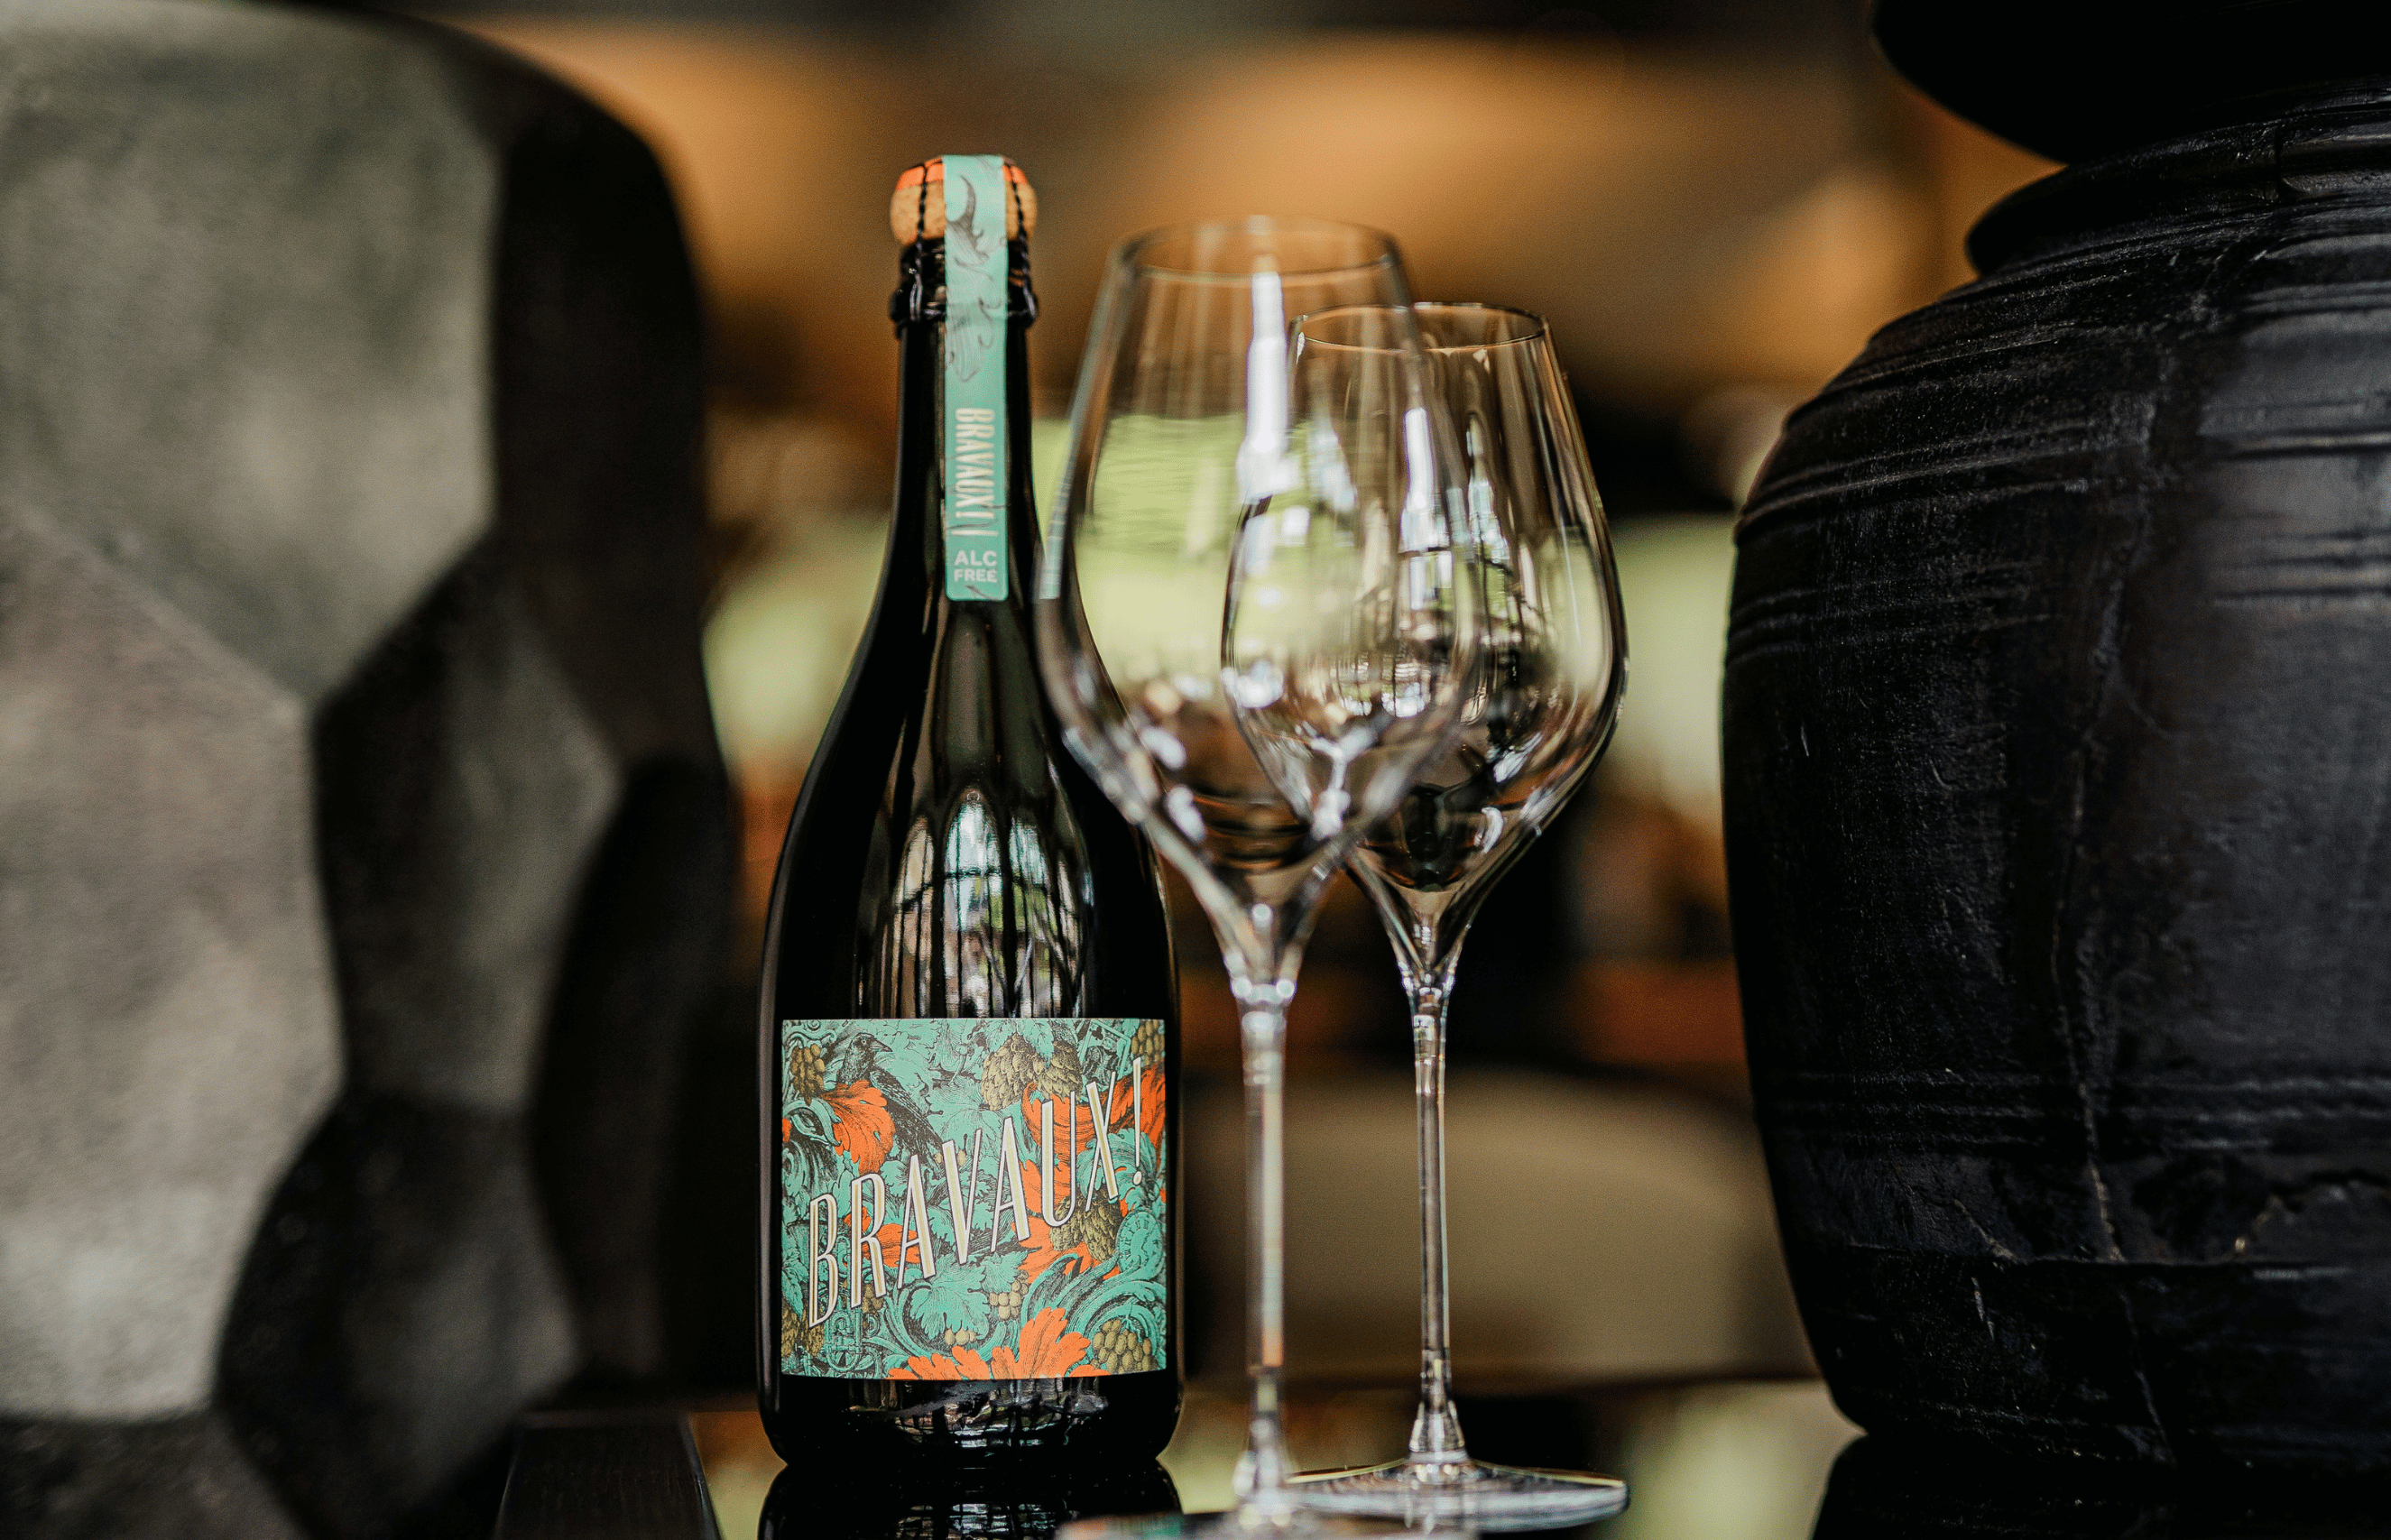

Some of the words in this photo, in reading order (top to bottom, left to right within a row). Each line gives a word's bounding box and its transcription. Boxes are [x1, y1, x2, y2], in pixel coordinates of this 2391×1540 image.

[955, 408, 995, 519] BRAVAUX!
[954, 549, 997, 567] ALC
[954, 568, 998, 583] FREE
[808, 1057, 1143, 1330] BRAVAUX!
